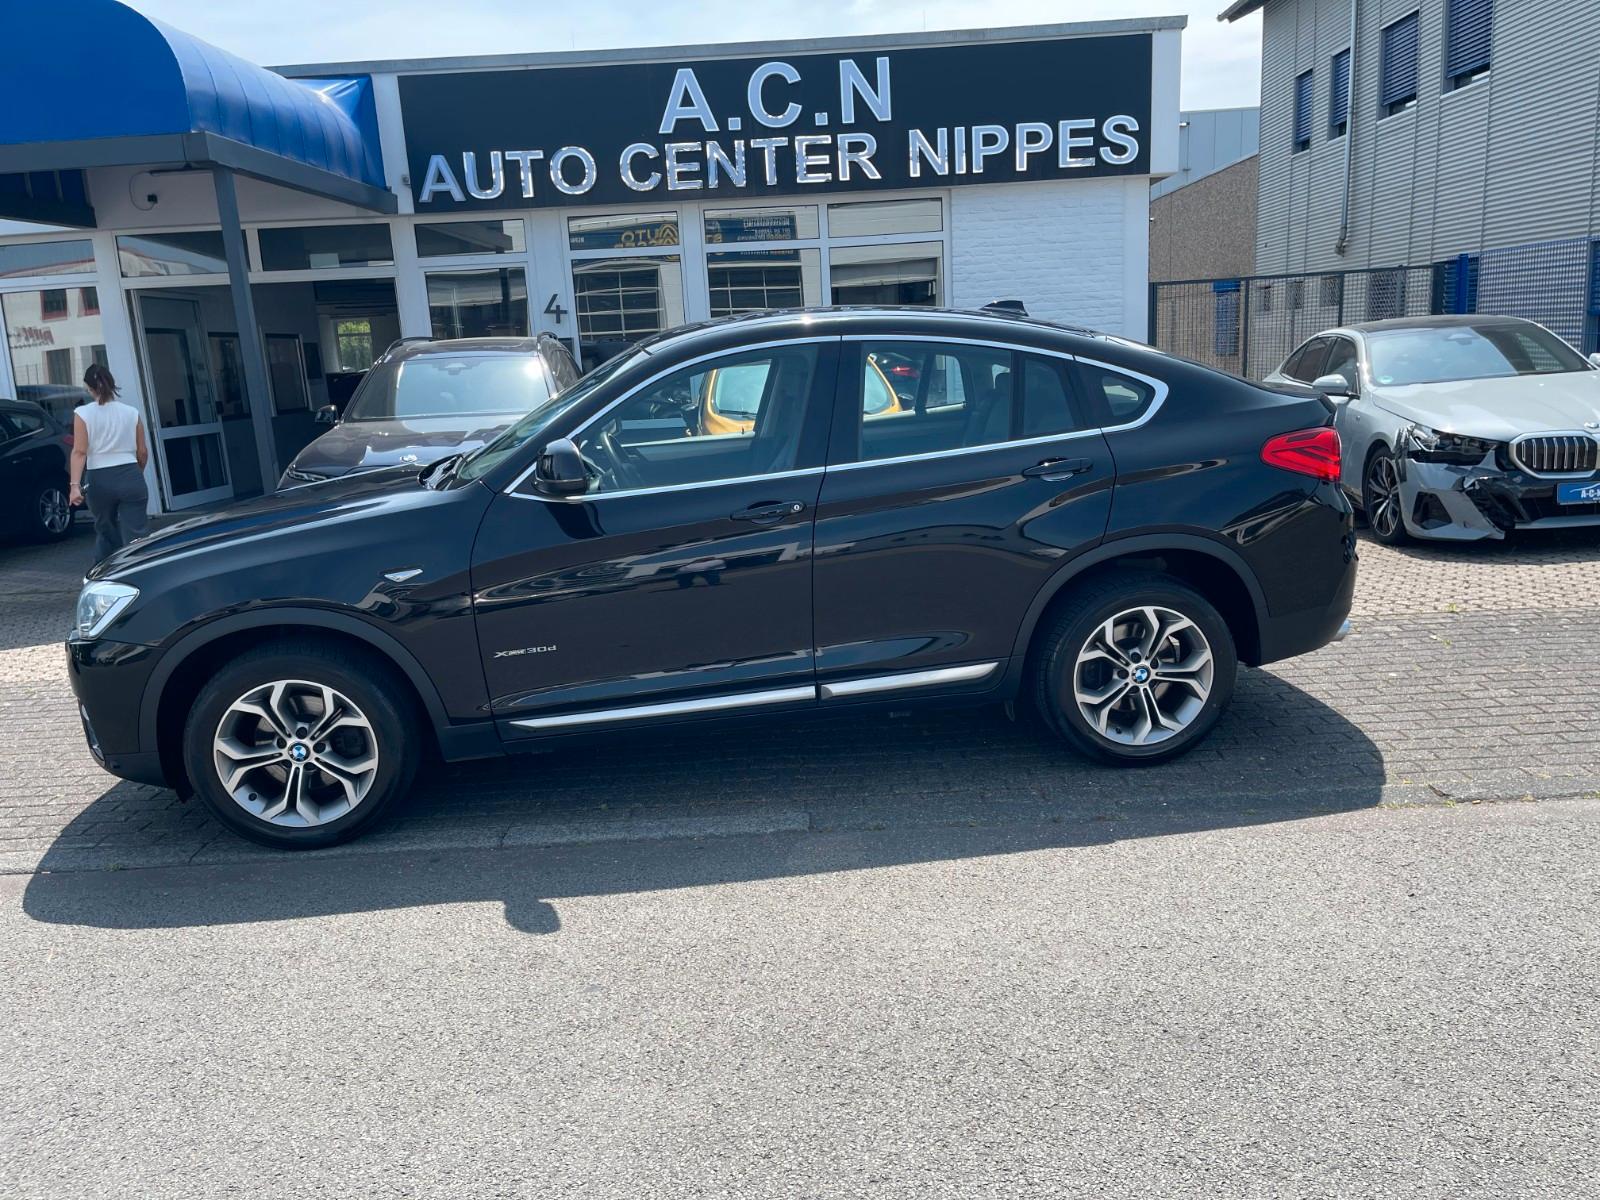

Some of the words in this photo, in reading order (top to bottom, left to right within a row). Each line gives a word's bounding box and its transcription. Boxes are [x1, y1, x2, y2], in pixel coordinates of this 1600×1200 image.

[659, 57, 891, 133] A.C.N
[419, 147, 597, 202] AUTO
[619, 134, 882, 191] CENTER
[909, 115, 1139, 177] NIPPES
[543, 293, 568, 324] 4
